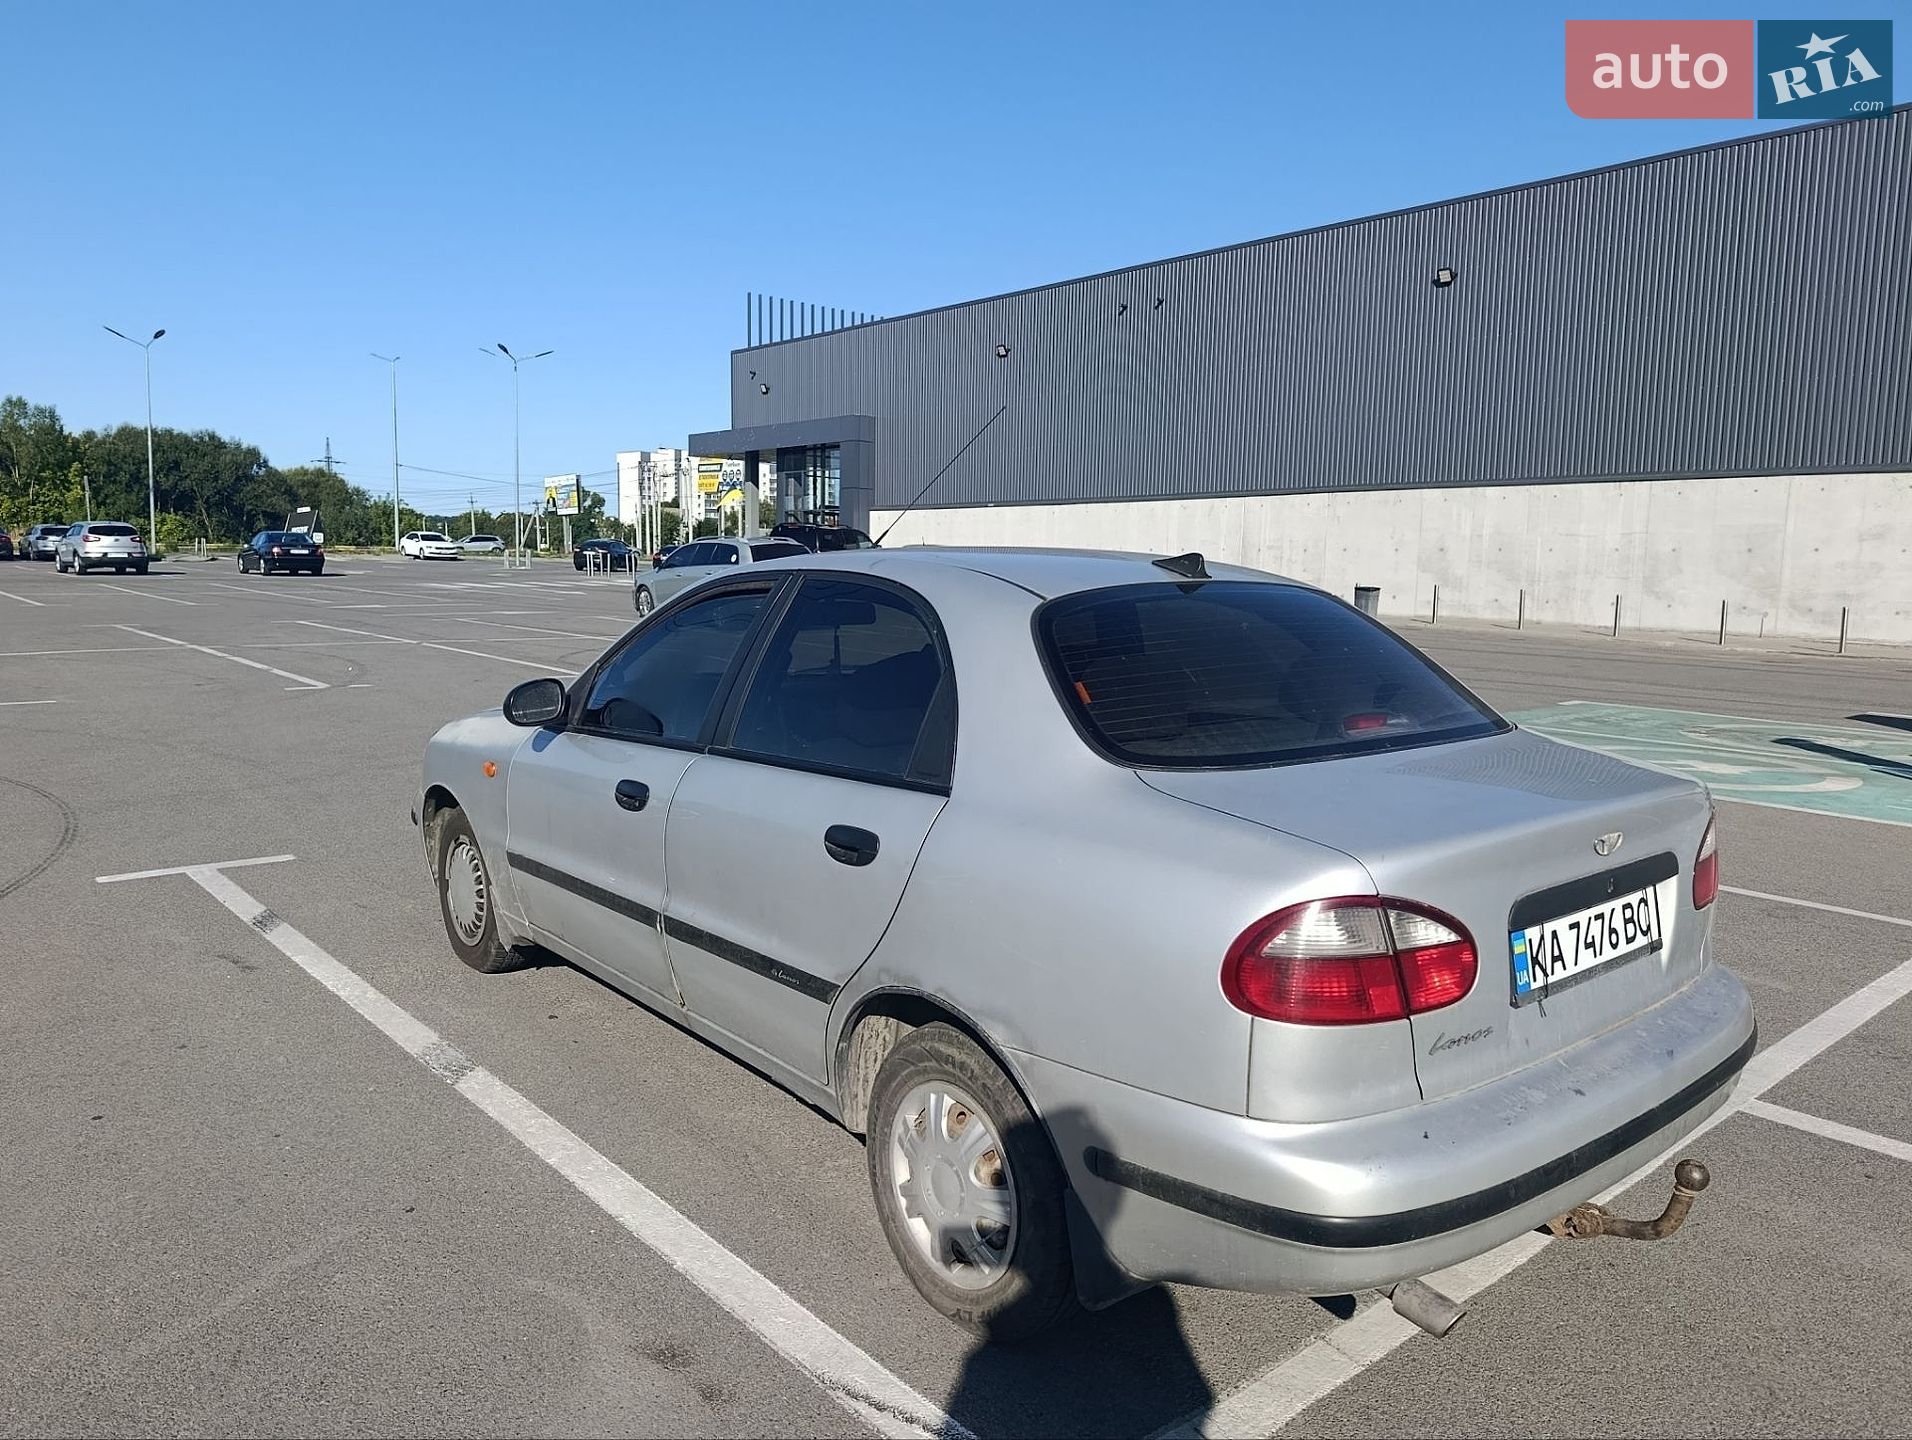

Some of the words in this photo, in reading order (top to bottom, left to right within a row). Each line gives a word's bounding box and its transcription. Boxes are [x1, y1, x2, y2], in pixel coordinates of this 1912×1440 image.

[1528, 929, 1567, 982] KA
[1568, 908, 1620, 967] 7476
[1516, 969, 1530, 986] UA
